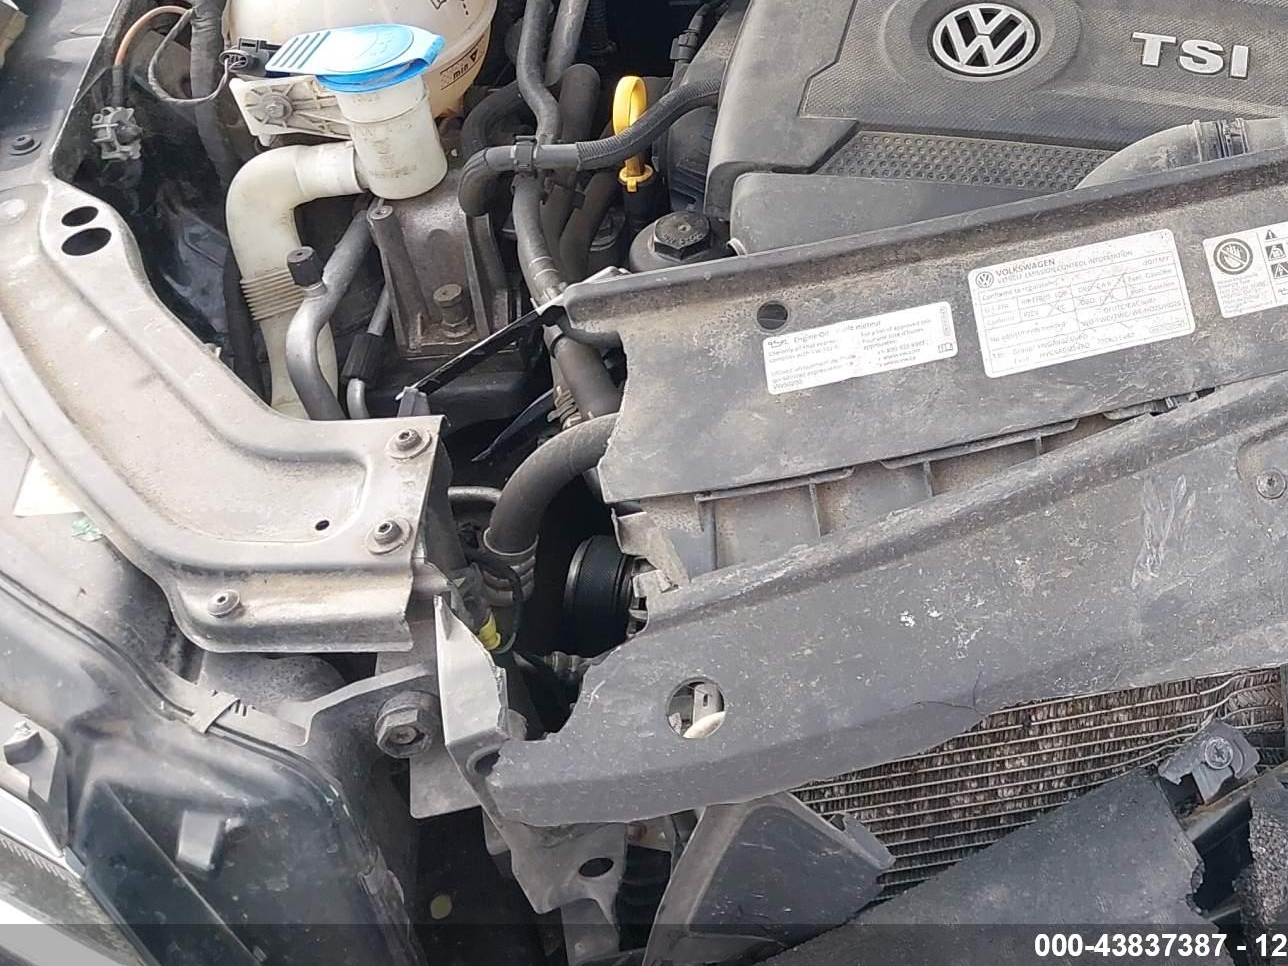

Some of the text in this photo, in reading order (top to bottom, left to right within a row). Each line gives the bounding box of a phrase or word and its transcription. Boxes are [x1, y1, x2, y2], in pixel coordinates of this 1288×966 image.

[1131, 31, 1249, 79] TSI
[453, 64, 470, 81] min
[995, 257, 1055, 277] VOLKSWAGEN
